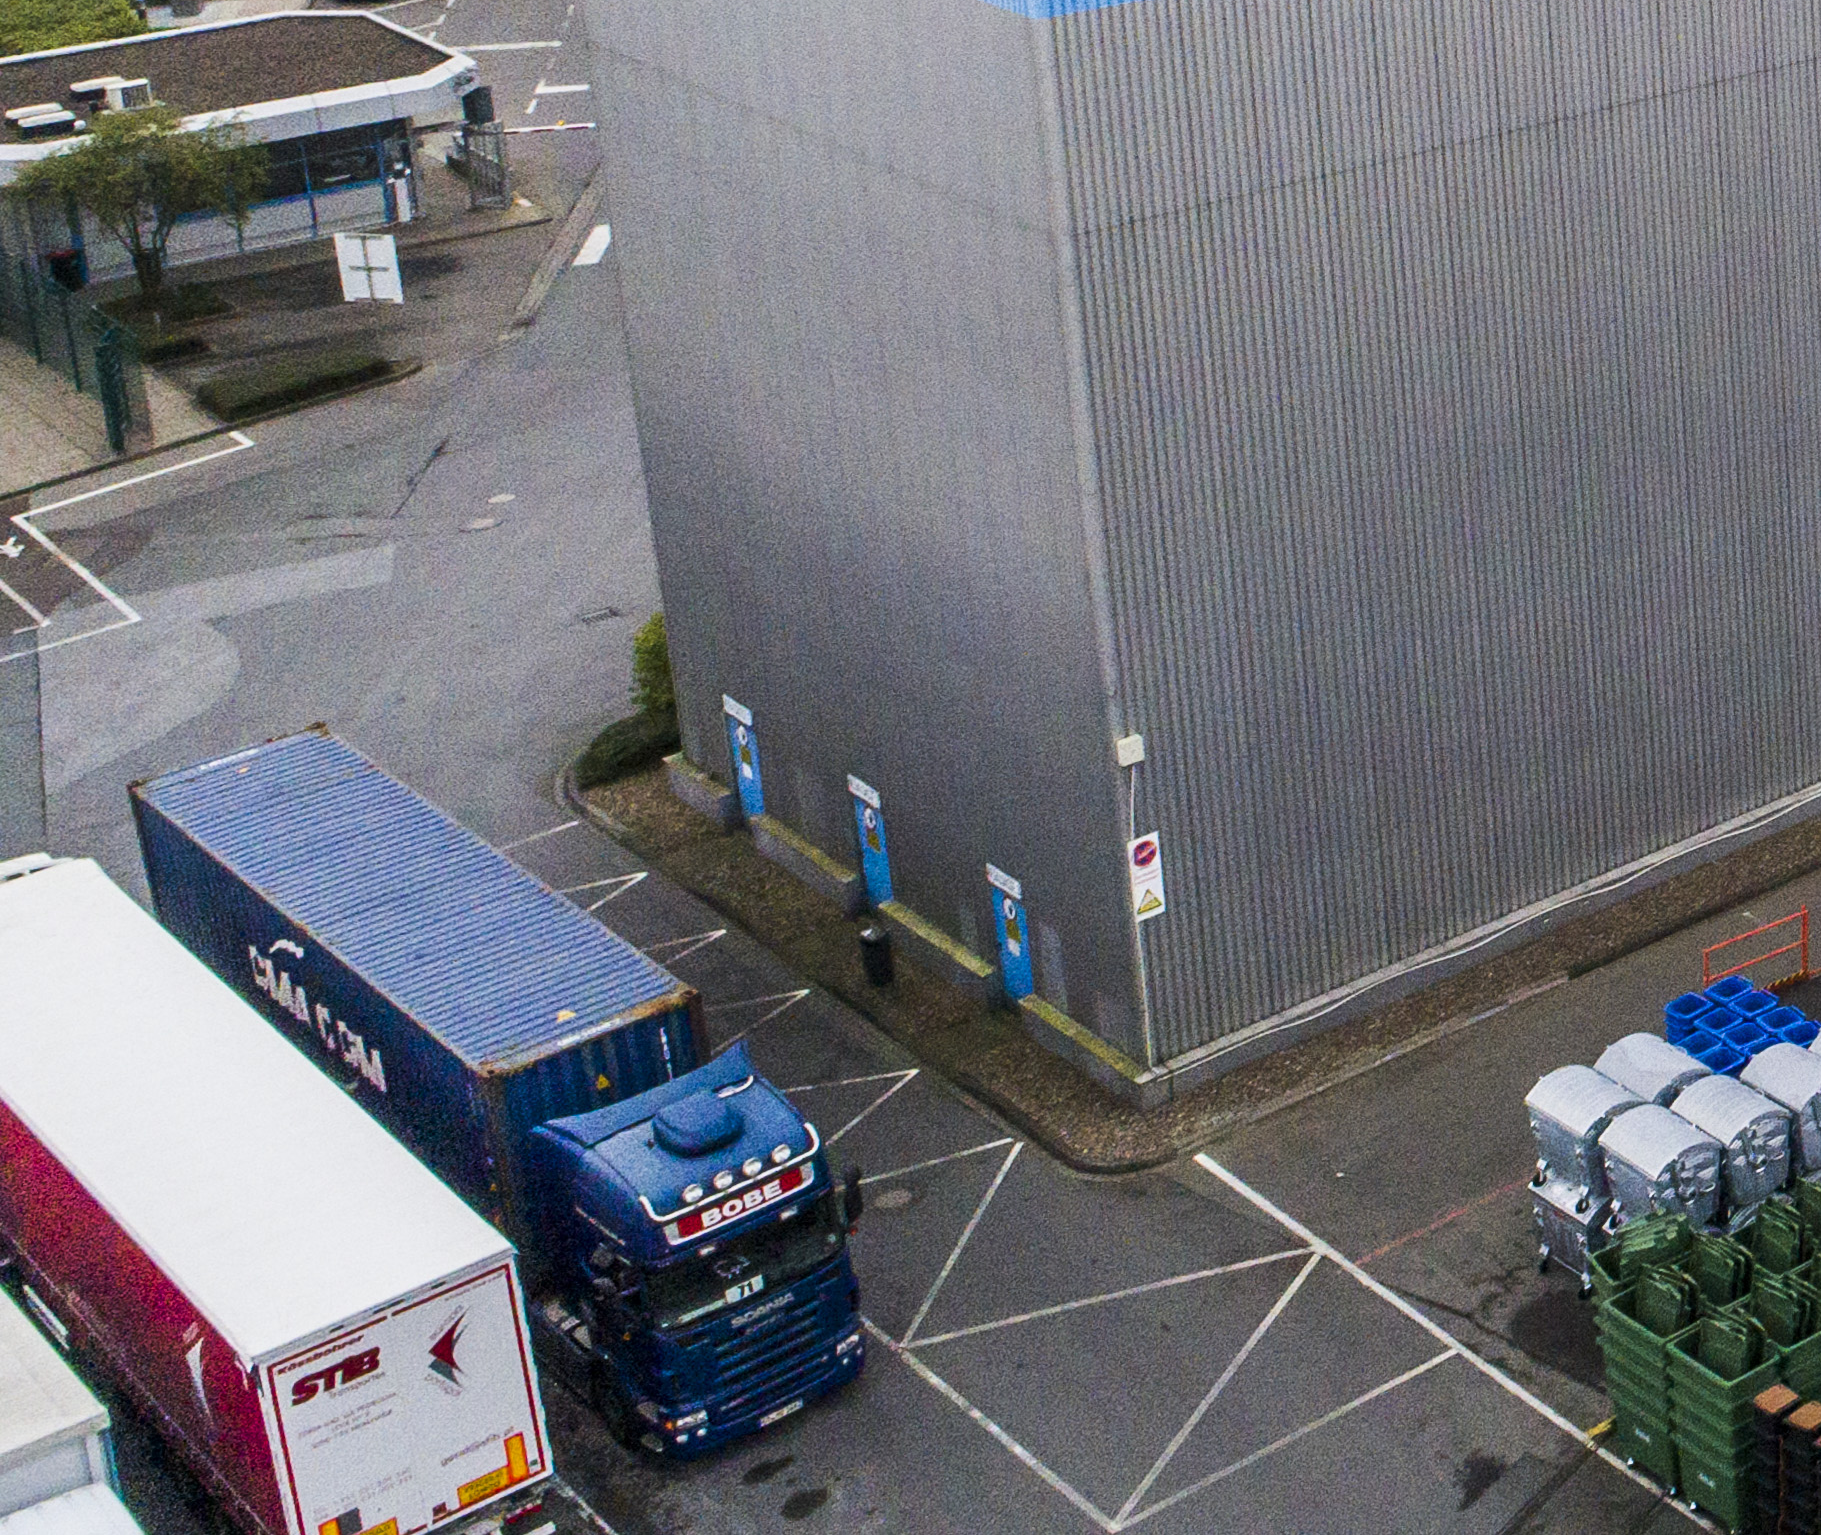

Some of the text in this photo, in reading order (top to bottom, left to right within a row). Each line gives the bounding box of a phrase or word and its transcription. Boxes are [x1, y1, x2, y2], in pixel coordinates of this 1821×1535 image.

[248, 944, 388, 1094] CMA CGM
[700, 1177, 784, 1229] BOBE
[730, 1292, 796, 1330] SCANIA
